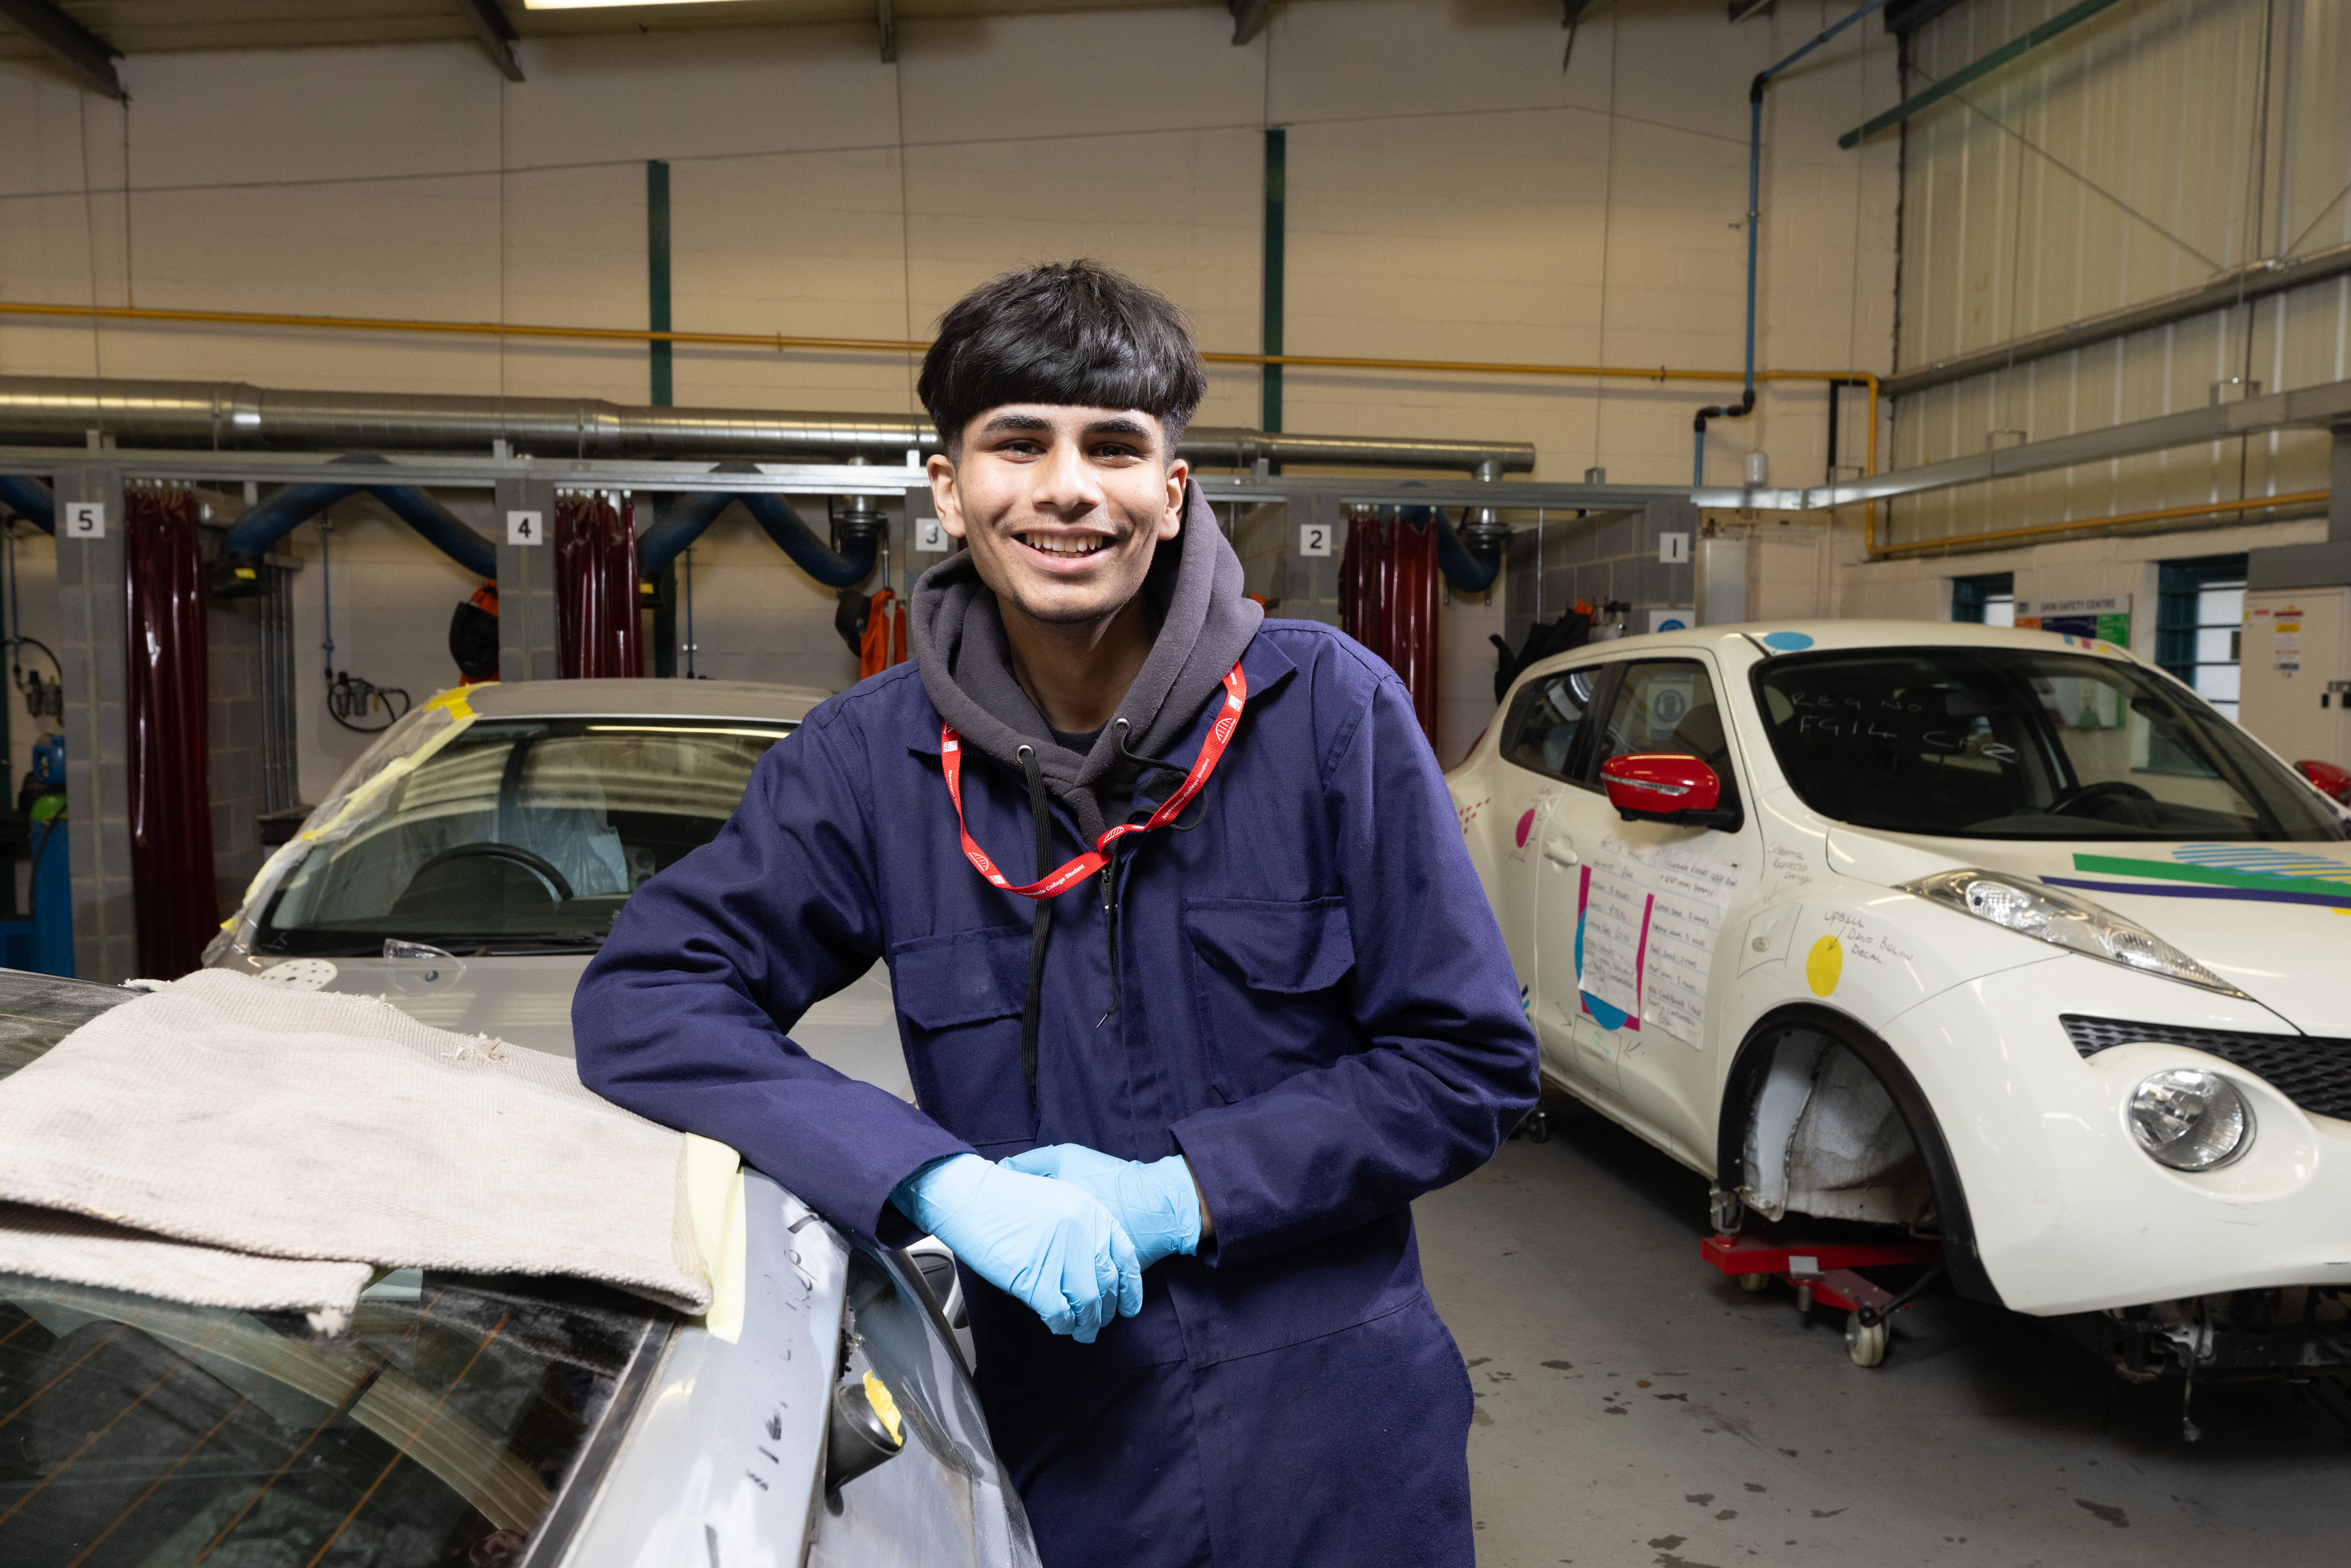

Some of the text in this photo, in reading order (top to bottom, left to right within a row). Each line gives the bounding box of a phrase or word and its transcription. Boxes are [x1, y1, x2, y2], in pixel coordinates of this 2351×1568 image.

[79, 509, 92, 531] 5
[518, 518, 531, 538] 4
[926, 525, 939, 544] 3
[1311, 530, 1322, 549] 2
[2059, 599, 2084, 610] SAFETY
[2087, 598, 2115, 609] CENTRE
[1162, 758, 1210, 820] Newcastle College Student
[1046, 877, 1066, 891] College
[1065, 864, 1086, 879] Student
